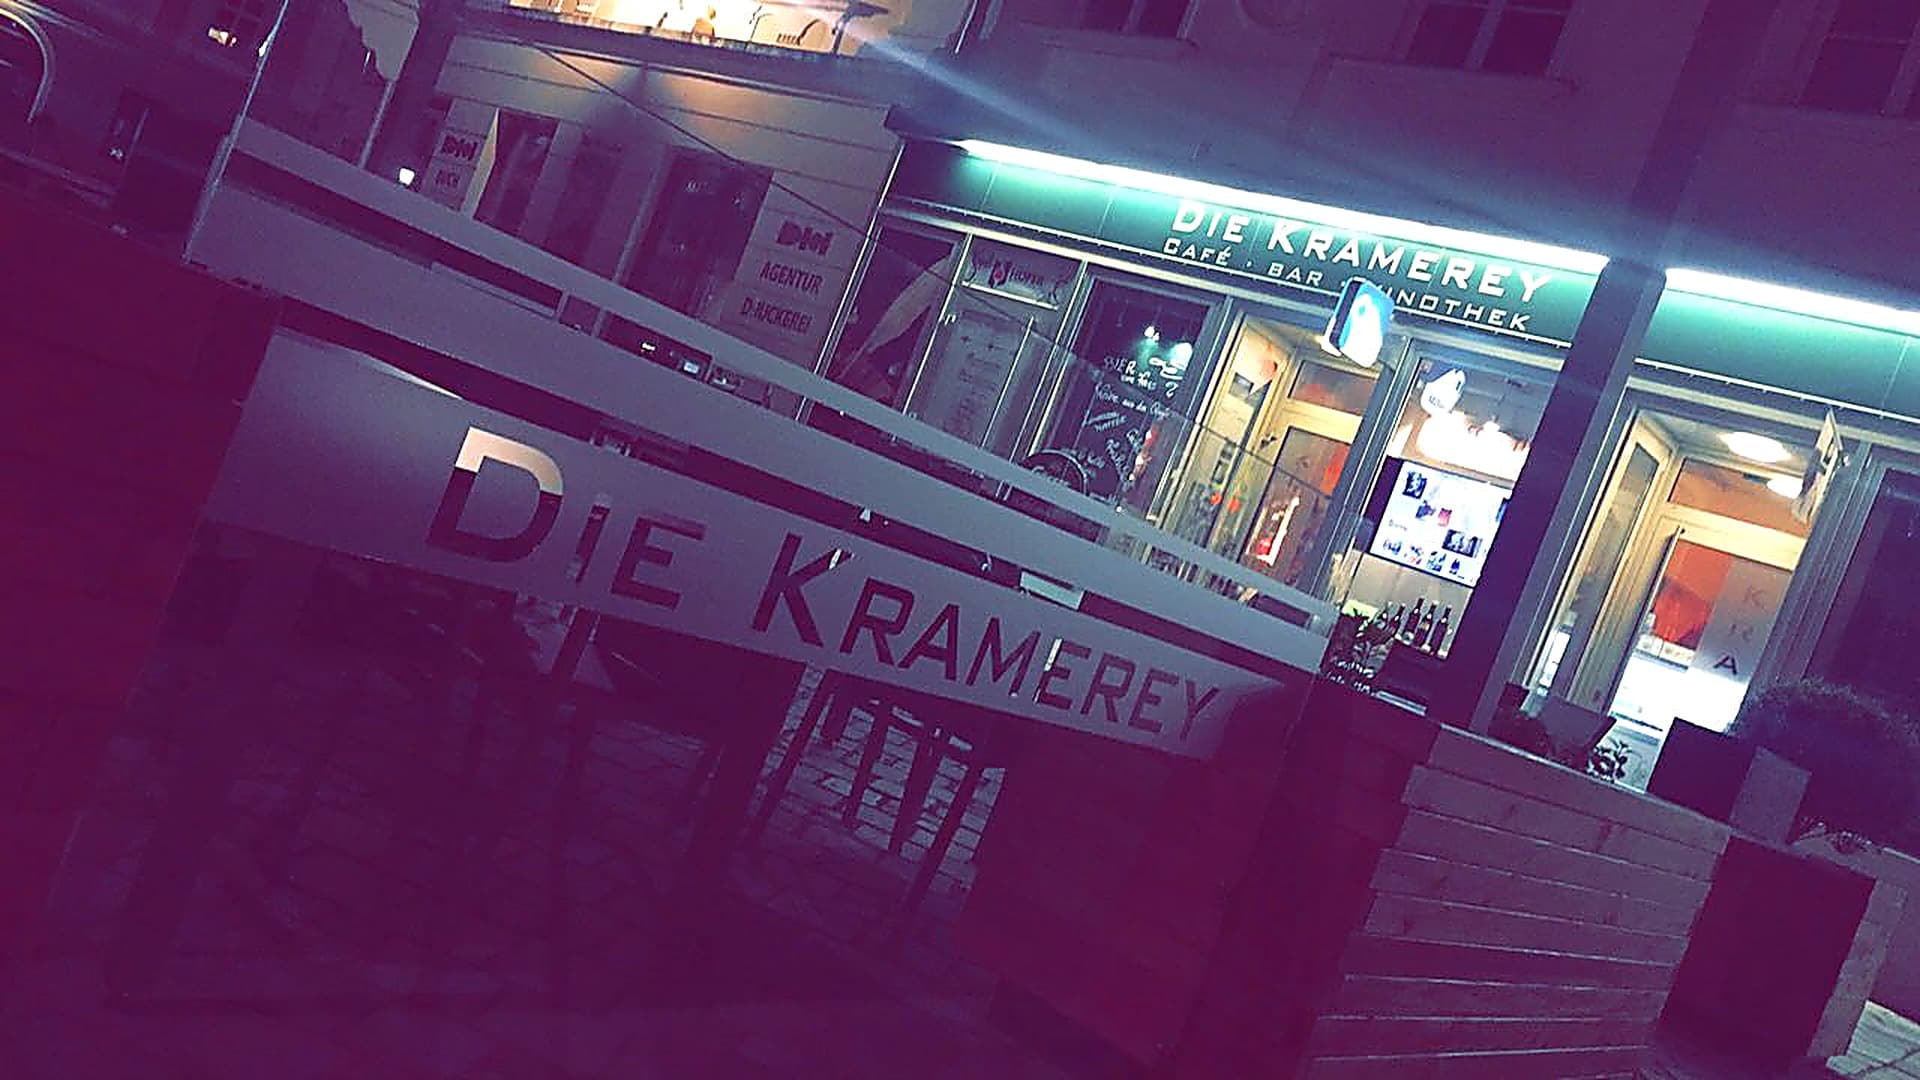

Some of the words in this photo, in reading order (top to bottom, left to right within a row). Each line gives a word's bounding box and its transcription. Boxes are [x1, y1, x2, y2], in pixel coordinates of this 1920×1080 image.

[759, 261, 823, 295] AGENTUR
[1163, 237, 1232, 267] CAFÉ
[1268, 262, 1324, 287] BAR
[1377, 284, 1531, 331] INOTHEK
[1172, 200, 1249, 243] DIE
[1268, 219, 1552, 303] KRAMEREY
[427, 425, 704, 609] DIE
[752, 534, 1220, 742] KRAMEREY
